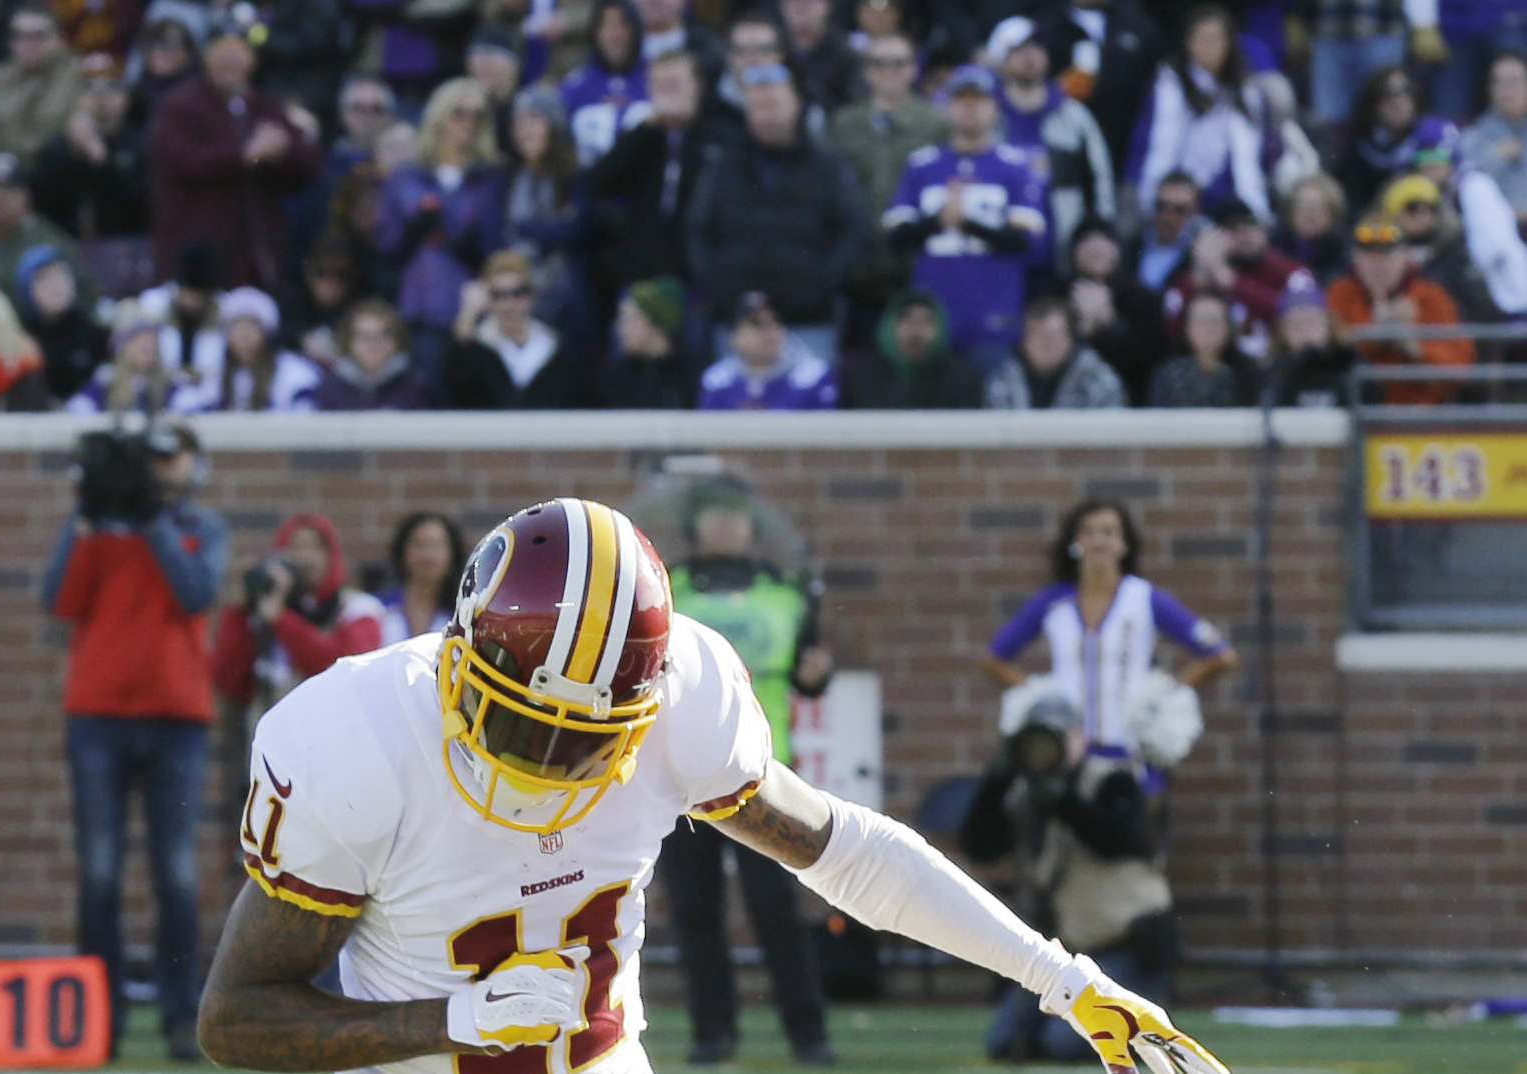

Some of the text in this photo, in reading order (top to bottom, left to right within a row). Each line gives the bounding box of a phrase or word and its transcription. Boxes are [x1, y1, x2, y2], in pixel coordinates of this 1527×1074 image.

[1380, 445, 1485, 506] 143
[541, 834, 563, 852] NFL
[520, 869, 585, 898] REDSKINS
[2, 976, 85, 1049] 10
